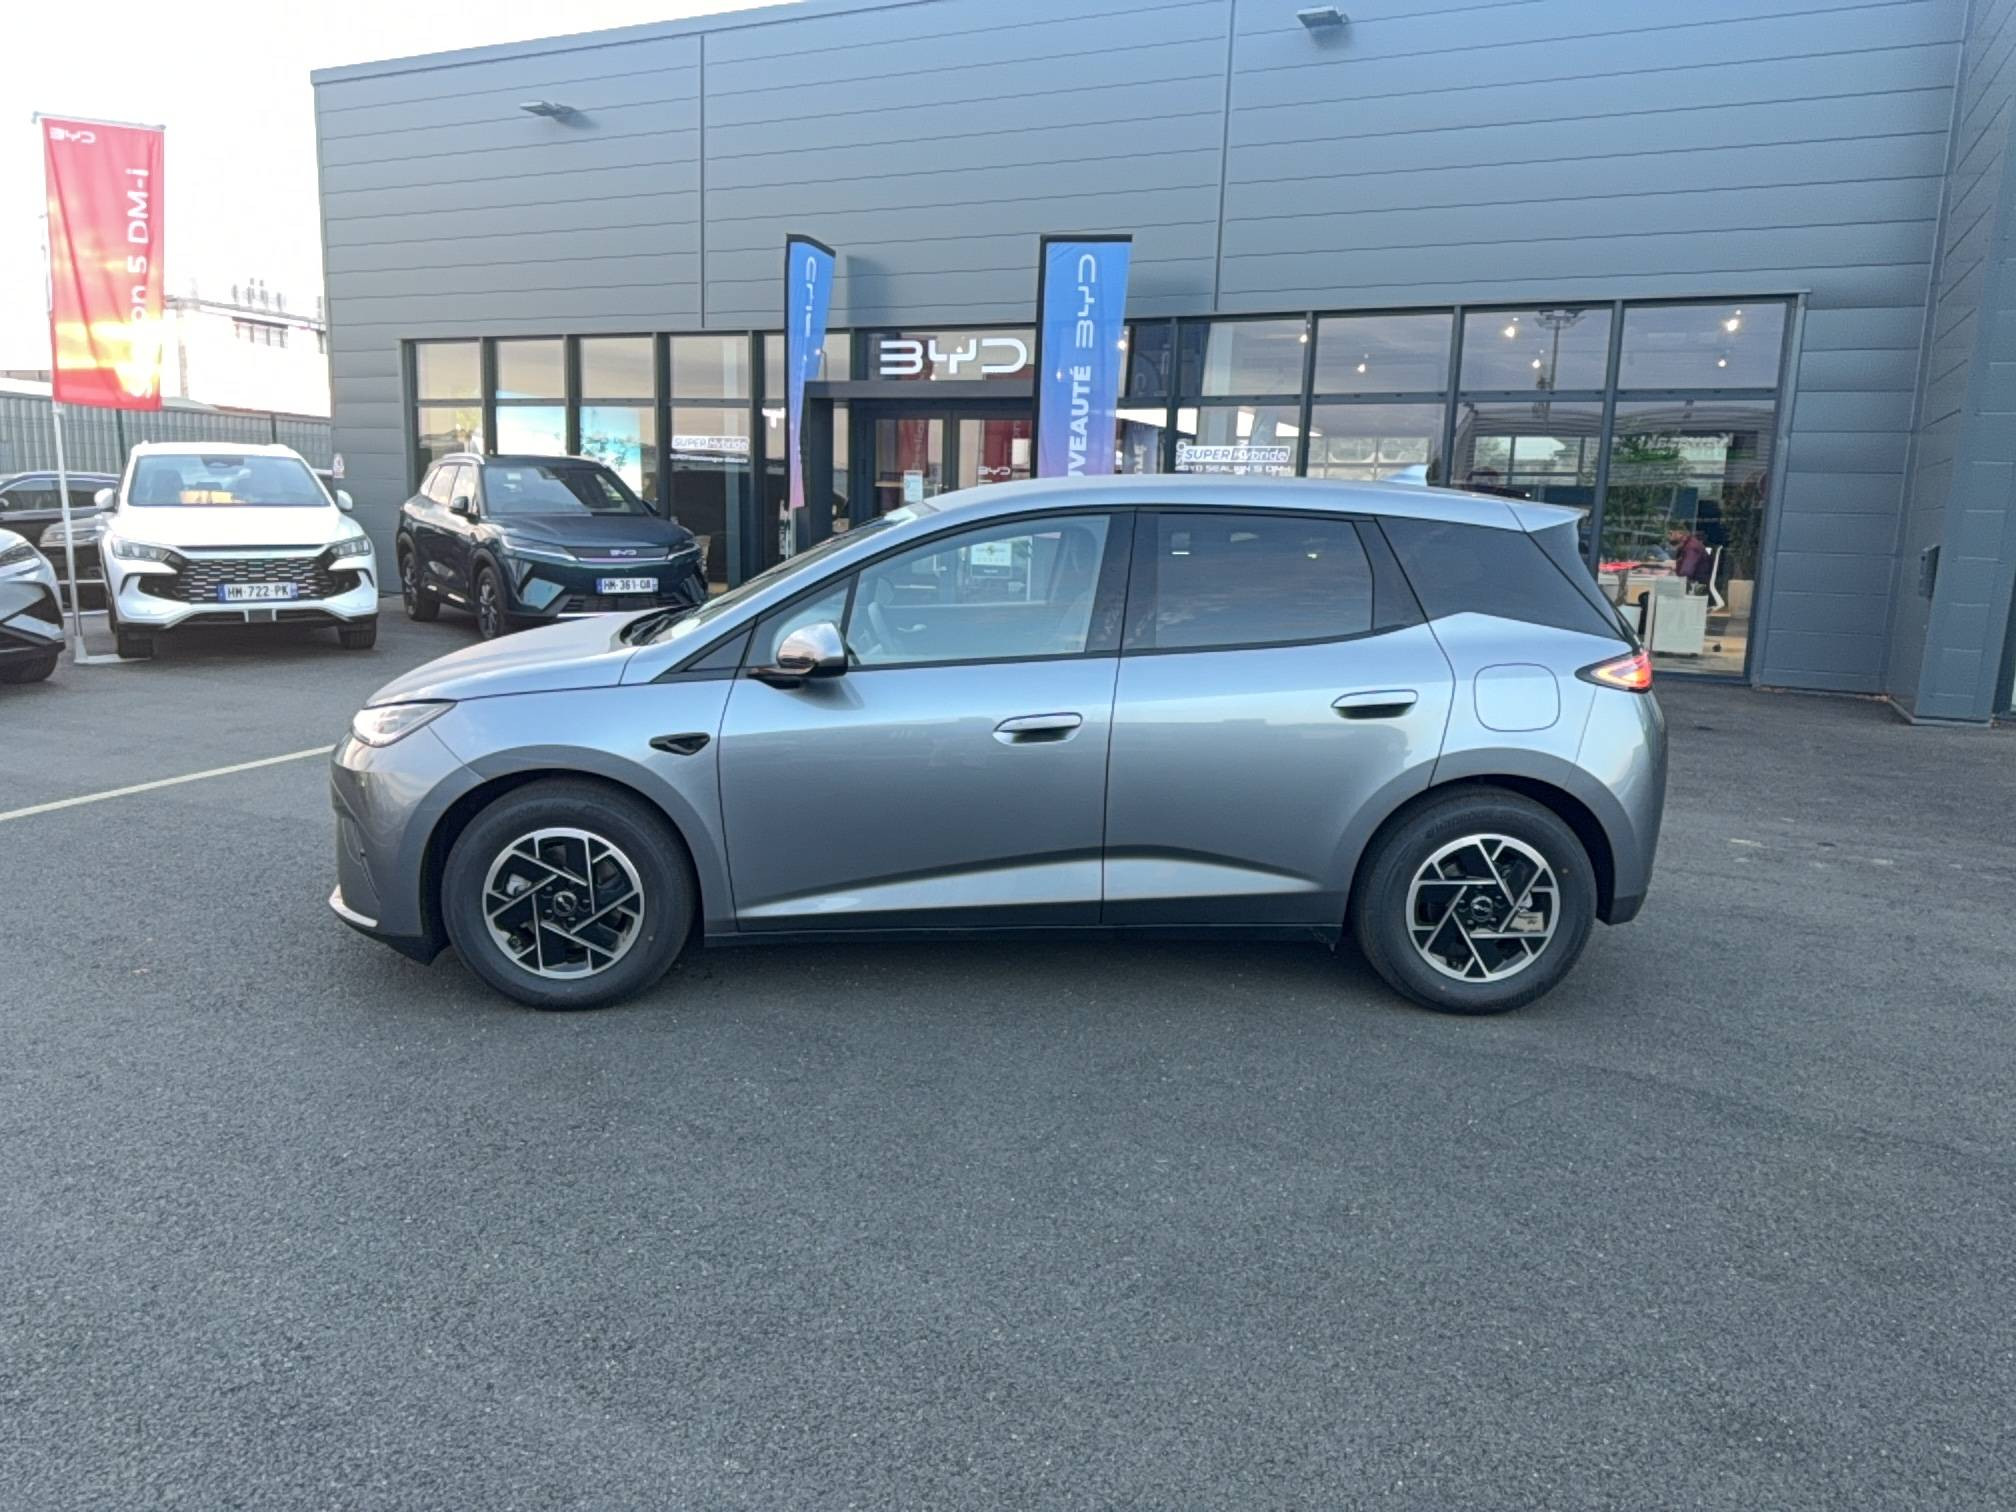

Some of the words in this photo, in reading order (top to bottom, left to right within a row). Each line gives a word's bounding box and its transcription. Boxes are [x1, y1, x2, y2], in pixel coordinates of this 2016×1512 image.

[49, 126, 96, 144] BYD
[1076, 253, 1096, 348] BYD
[879, 338, 1027, 375] BYD
[1185, 448, 1232, 460] SUPER
[978, 466, 1010, 476] BYD
